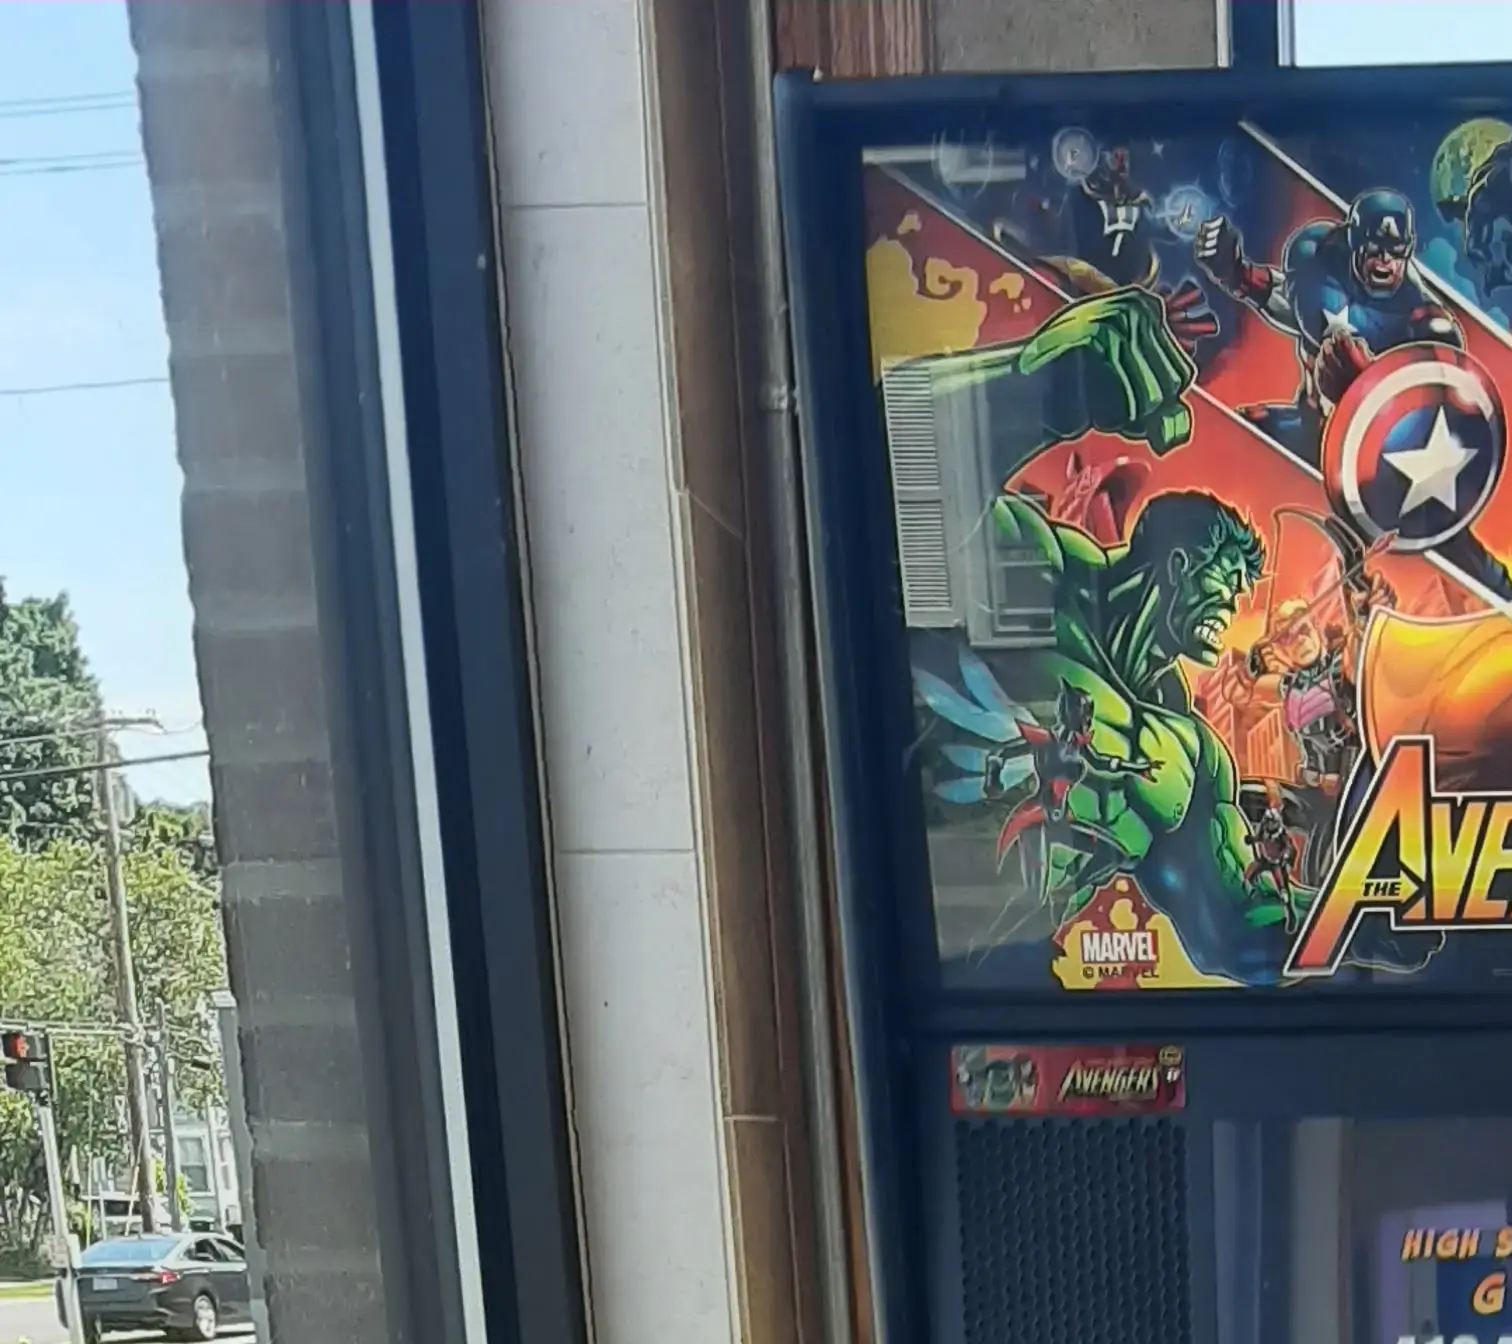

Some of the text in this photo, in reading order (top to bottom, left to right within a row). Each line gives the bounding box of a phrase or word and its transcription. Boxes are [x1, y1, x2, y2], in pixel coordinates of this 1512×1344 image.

[1362, 880, 1402, 897] THE
[1082, 931, 1157, 963] MARVEL
[1401, 1227, 1480, 1262] HIGH
[1471, 1273, 1507, 1316] G
